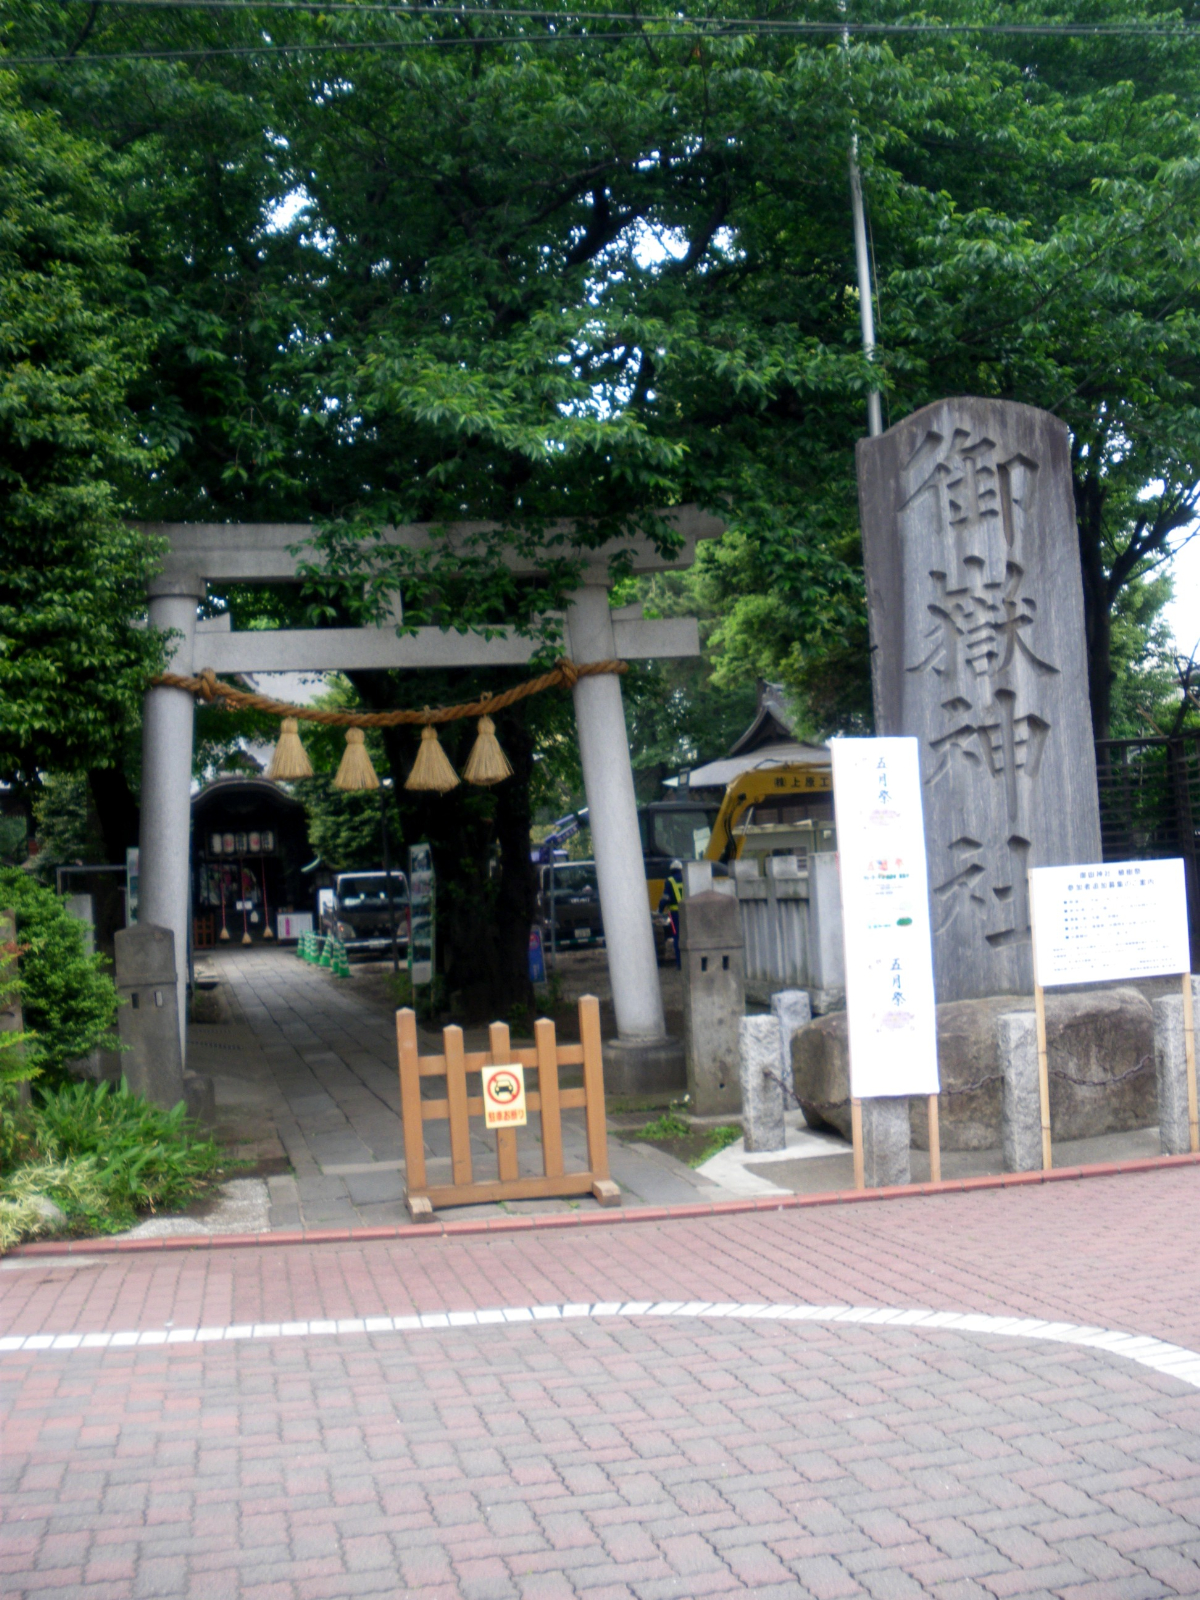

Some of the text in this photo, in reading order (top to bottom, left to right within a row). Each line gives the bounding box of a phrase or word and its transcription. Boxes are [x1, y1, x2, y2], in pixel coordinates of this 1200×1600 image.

[897, 428, 1060, 948] 御嶽神社
[876, 757, 892, 805] 五月祭
[890, 957, 906, 1007] 五月祭
